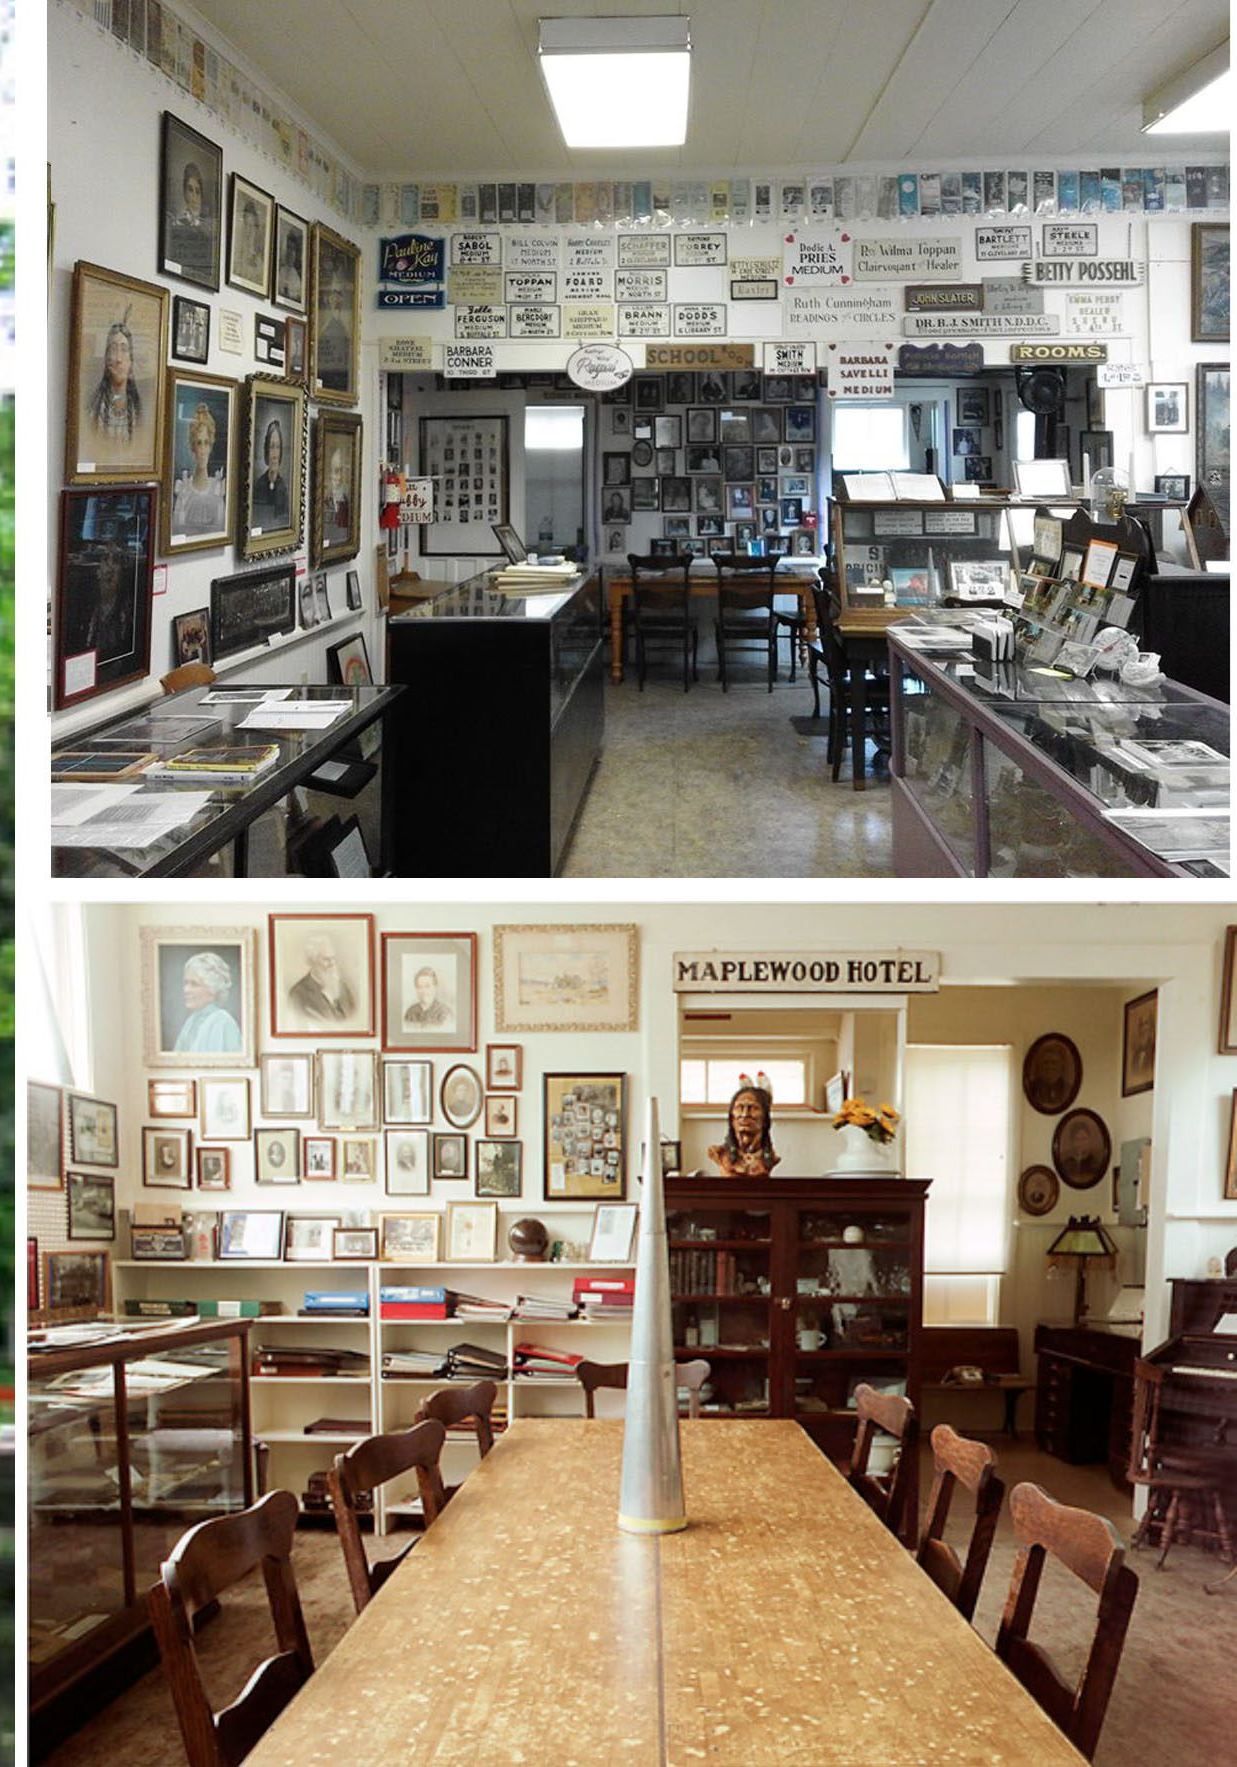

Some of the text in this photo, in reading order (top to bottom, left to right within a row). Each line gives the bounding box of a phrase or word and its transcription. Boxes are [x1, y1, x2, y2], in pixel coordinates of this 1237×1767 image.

[979, 234, 1028, 244] BARTLETT
[458, 242, 492, 250] SABOL
[879, 244, 912, 256] Wilma
[918, 243, 956, 257] Toppan
[384, 239, 435, 268] Pauline
[799, 253, 836, 263] PRIES
[408, 251, 439, 270] Kay
[792, 265, 843, 274] MEDIUM
[858, 259, 959, 273] Clairvoyant Healer
[1035, 261, 1137, 281] BETTY POSSEHL
[508, 279, 552, 287] TOPPAN
[566, 278, 603, 286] FOARD
[618, 276, 662, 285] MORRIS
[384, 295, 437, 304] OPEN
[794, 297, 892, 310] Ruth Cunningham
[938, 293, 974, 304] SLATER
[458, 315, 505, 323] FERGUSON
[679, 311, 717, 320] DODDS
[790, 314, 838, 323] READINGS
[853, 313, 896, 323] CIRCLES
[916, 318, 935, 328] DR.
[961, 318, 1001, 327] SMITH
[447, 346, 493, 356] BARBARA
[647, 349, 721, 363] SCHOOL
[776, 350, 803, 360] SMITH
[1019, 346, 1106, 358] ROOMS.
[447, 358, 493, 367] CONNER
[840, 356, 888, 364] BARBARA
[840, 370, 888, 378] SAVELLI
[843, 386, 892, 394] MEDIUM
[678, 960, 932, 983] MAPLEWOOD HOTEL
